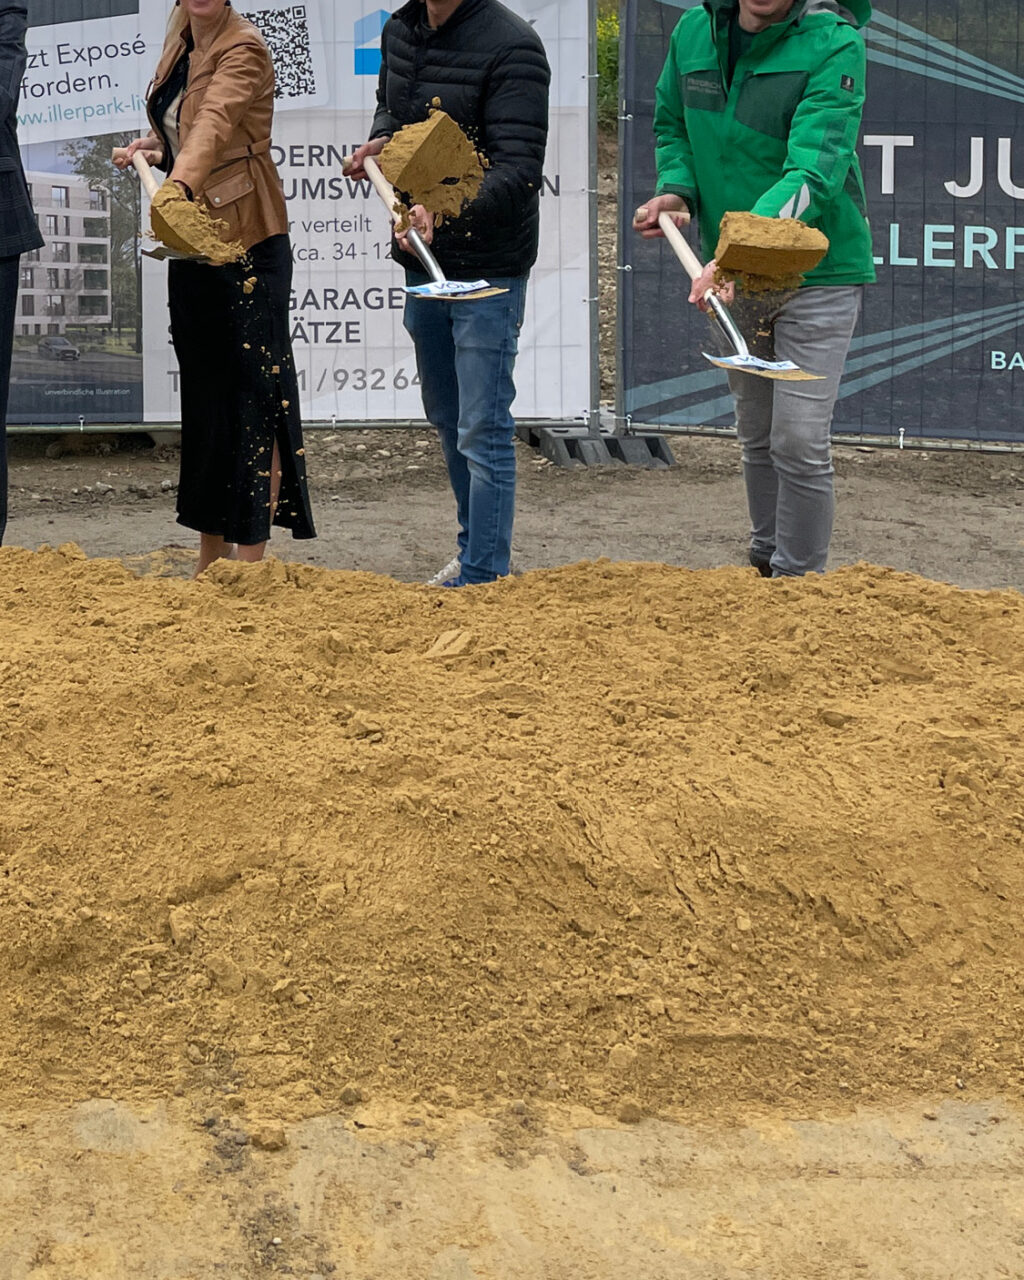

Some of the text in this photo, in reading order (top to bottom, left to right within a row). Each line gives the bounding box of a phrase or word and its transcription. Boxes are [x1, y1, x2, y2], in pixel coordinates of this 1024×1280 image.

[56, 33, 146, 67] Exposé
[301, 214, 372, 233] verteilt
[333, 368, 386, 391] 932
